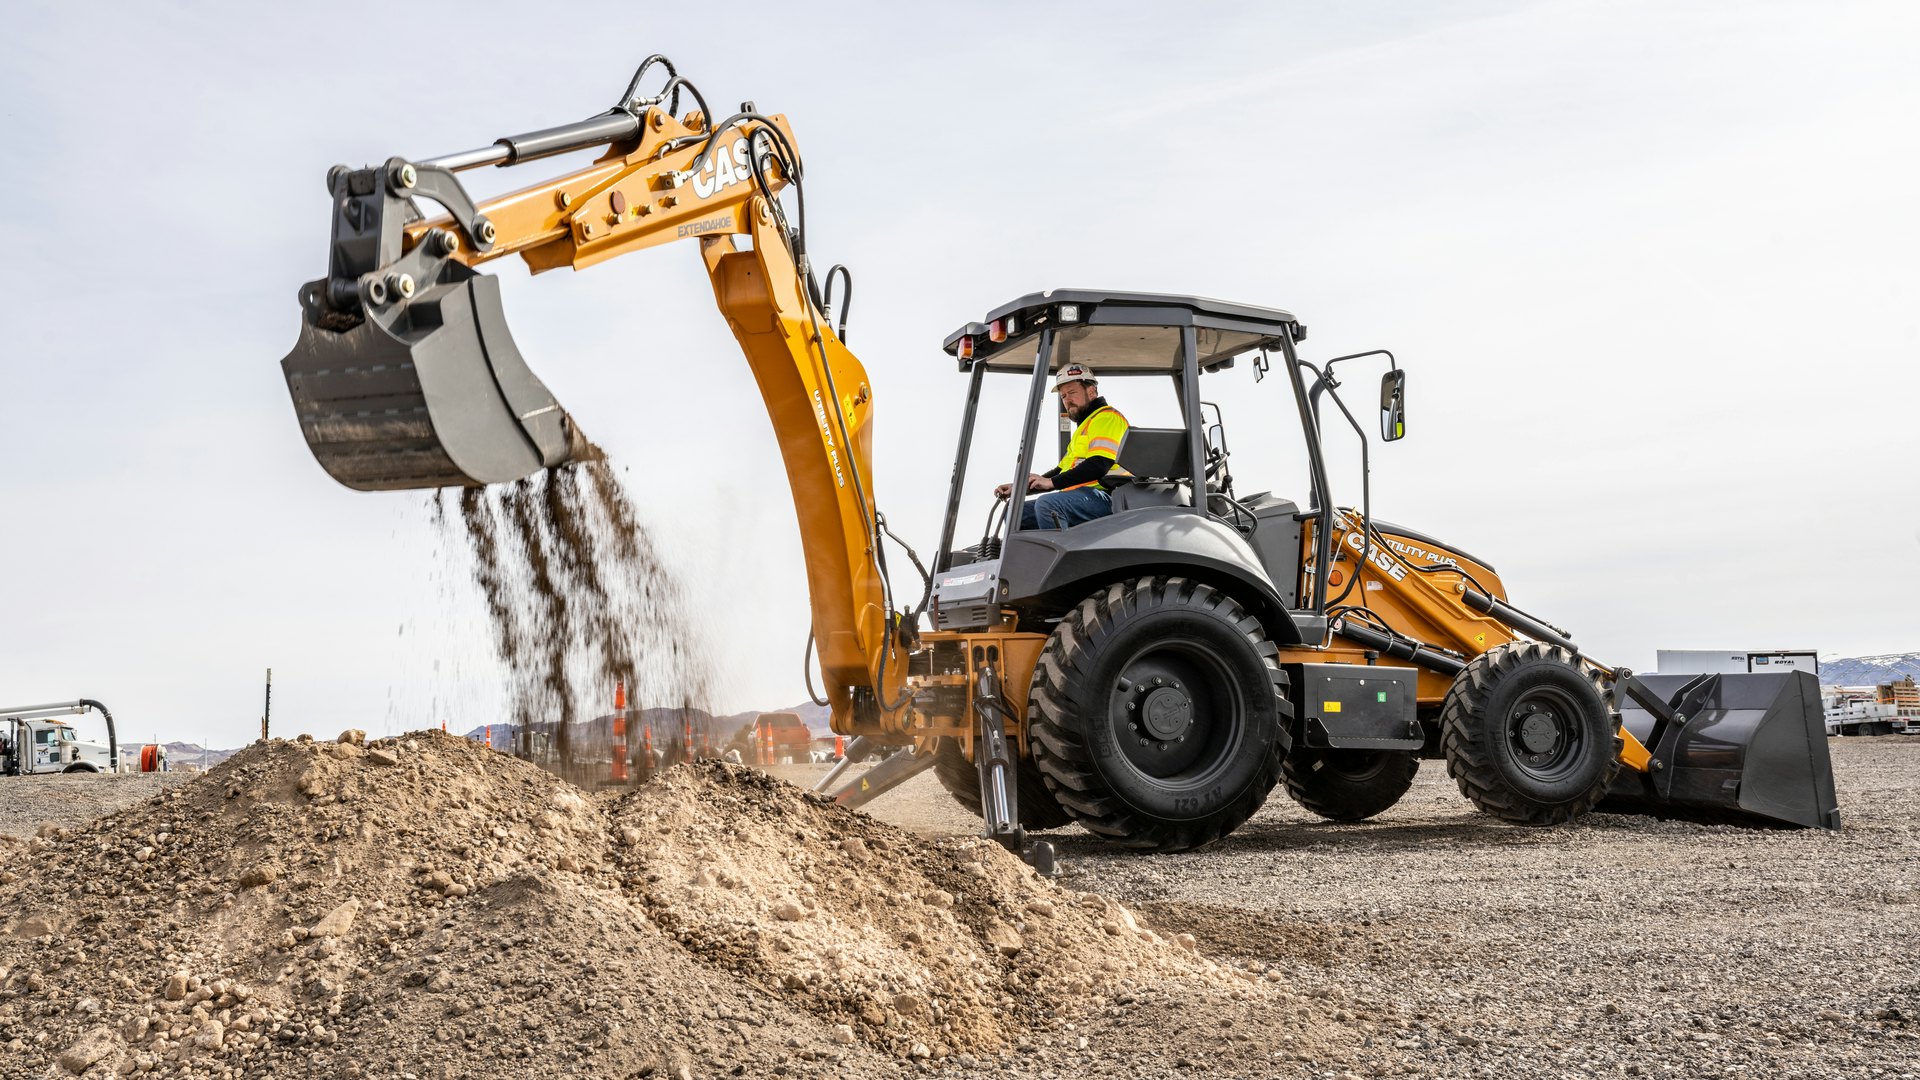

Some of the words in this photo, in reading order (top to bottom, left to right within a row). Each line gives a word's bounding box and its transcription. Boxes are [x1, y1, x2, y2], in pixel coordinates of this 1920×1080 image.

[677, 216, 732, 237] EXTENDAHOE
[814, 389, 835, 447] UTILITY
[831, 449, 845, 488] PLUS
[1347, 531, 1409, 582] CASE
[1426, 551, 1457, 567] PLUS
